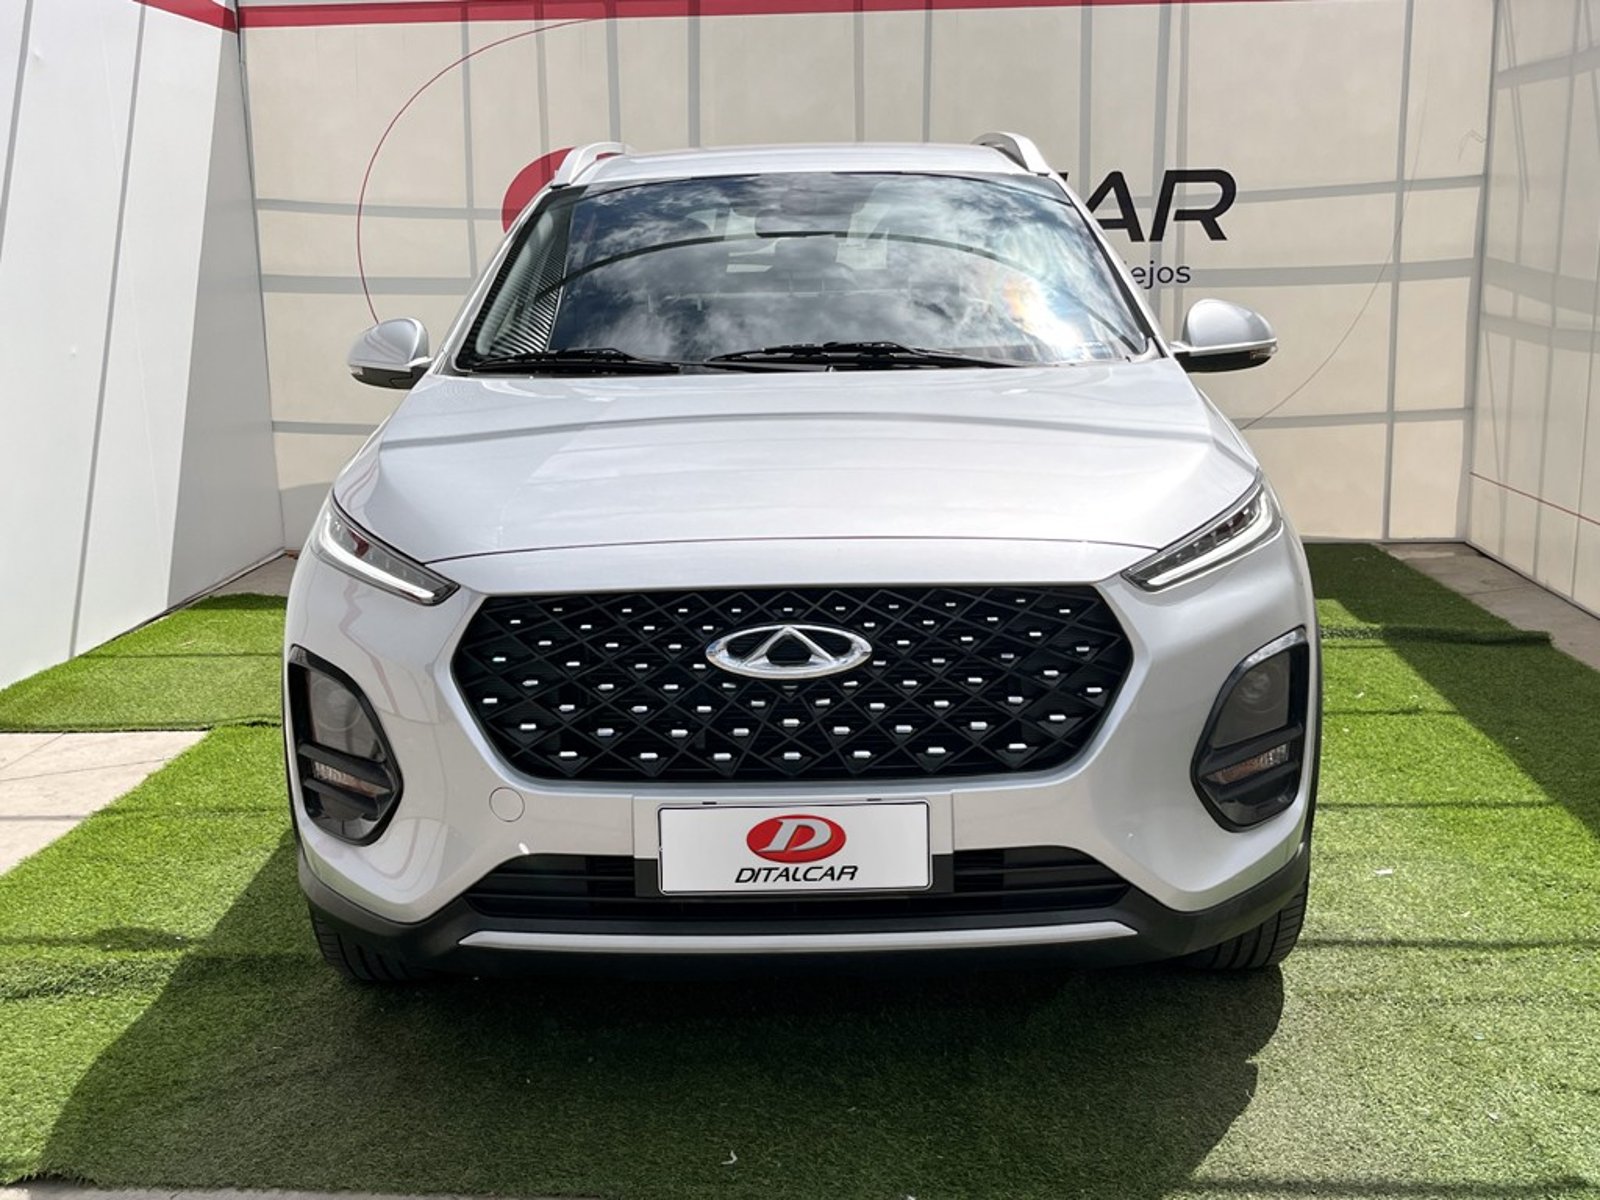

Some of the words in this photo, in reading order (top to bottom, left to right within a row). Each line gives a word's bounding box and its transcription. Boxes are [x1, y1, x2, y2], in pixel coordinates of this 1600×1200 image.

[1059, 169, 1237, 241] AR
[1126, 260, 1191, 290] ejos
[757, 818, 832, 851] D
[735, 865, 859, 883] DITALCAR
